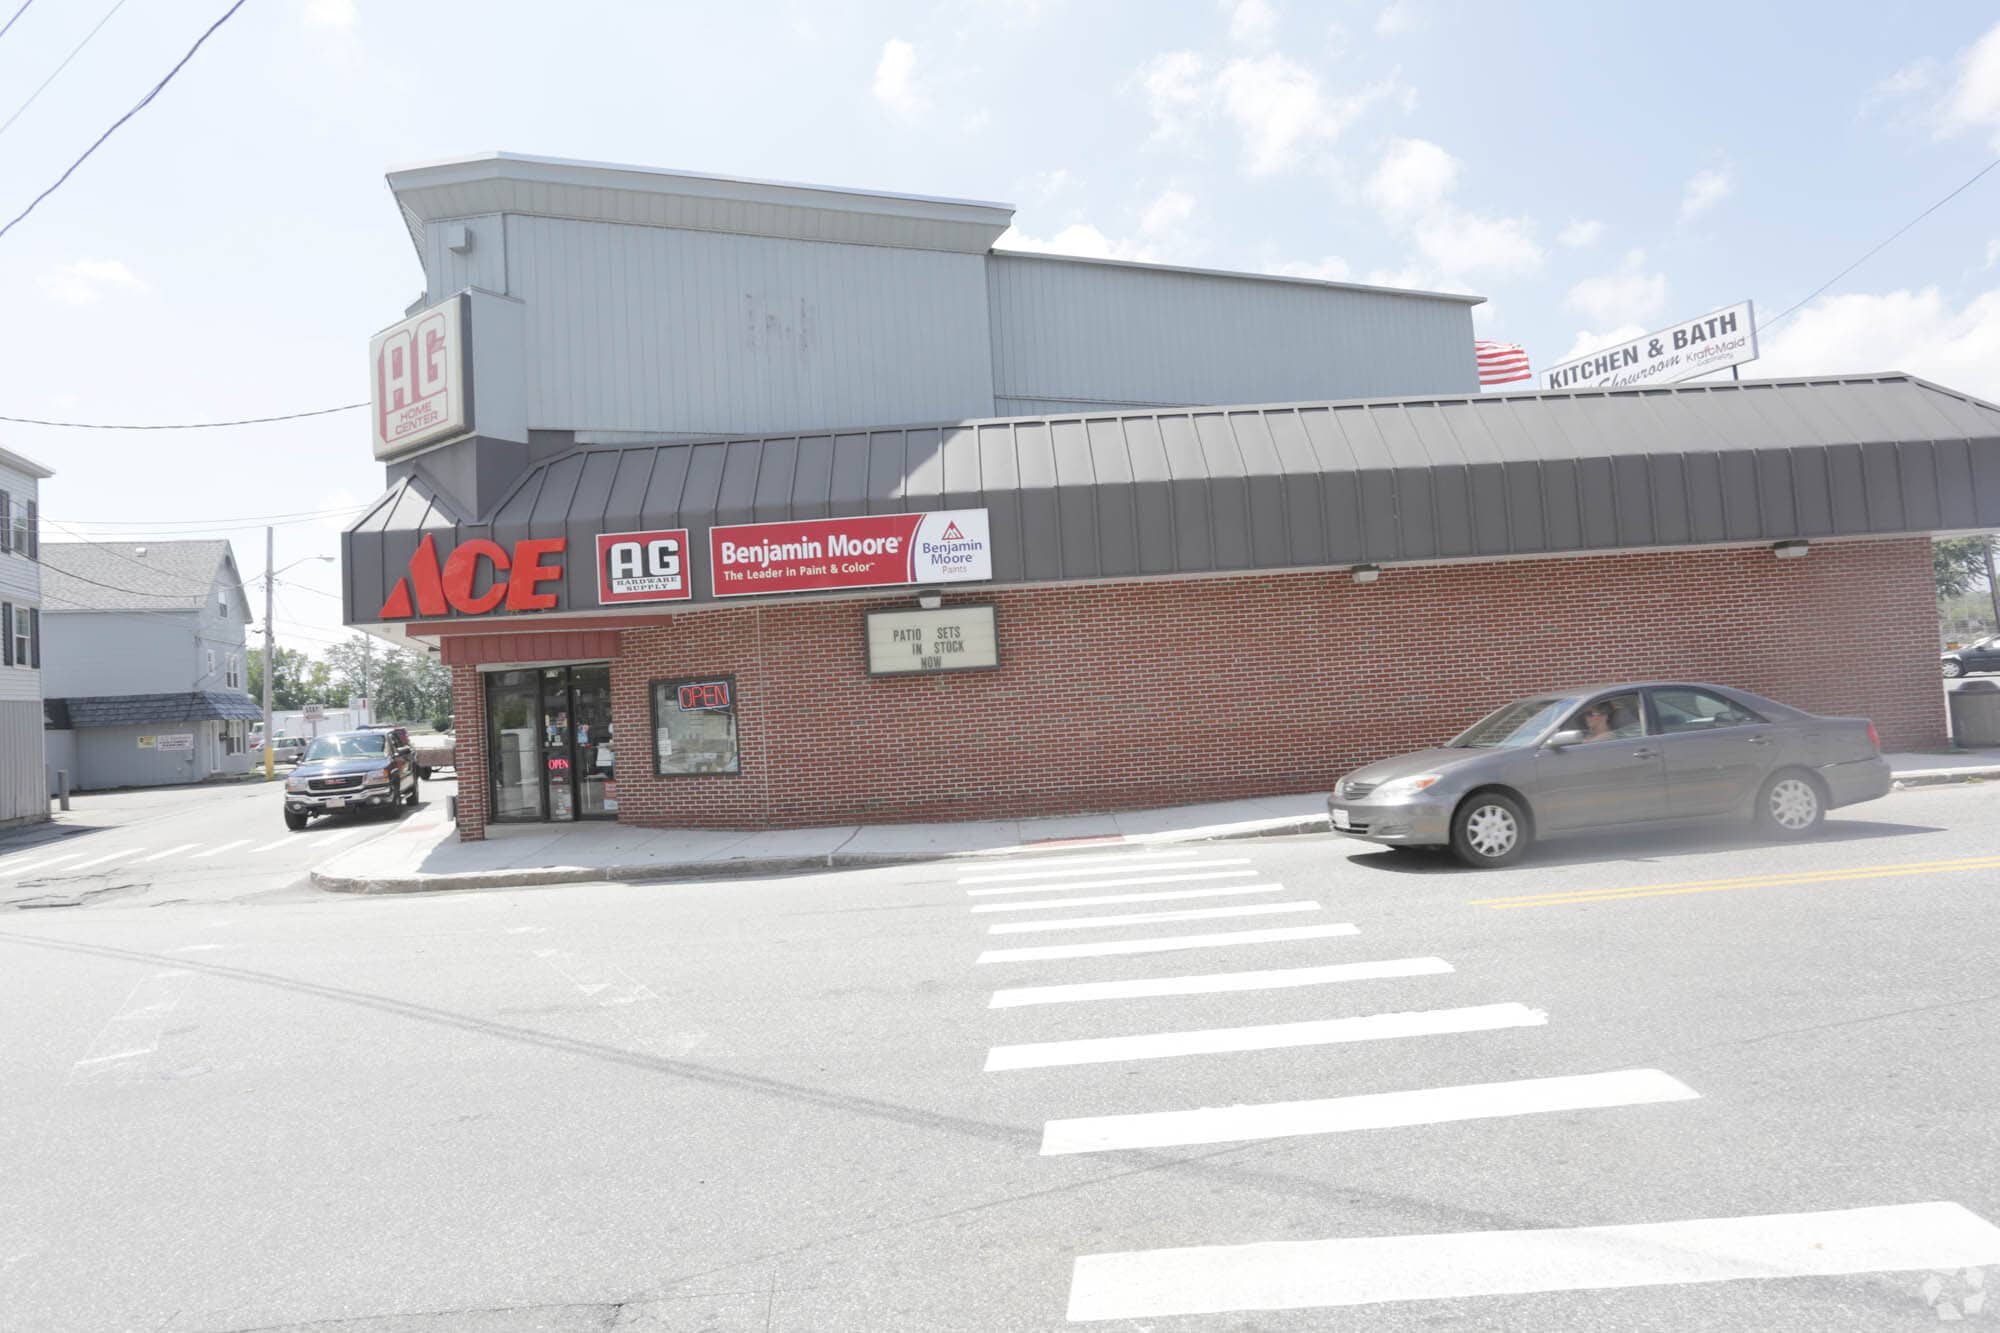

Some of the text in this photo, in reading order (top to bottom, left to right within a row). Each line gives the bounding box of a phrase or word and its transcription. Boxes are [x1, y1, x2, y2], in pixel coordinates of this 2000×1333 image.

[1549, 311, 1737, 389] KITCHEN & BATH
[379, 312, 447, 414] AG
[401, 401, 432, 421] HOME
[395, 411, 438, 435] CENTER
[721, 536, 822, 568] Benjamin
[923, 539, 982, 556] Benjamin
[611, 540, 680, 578] AG
[931, 554, 973, 565] Moore
[378, 532, 567, 619] ACE
[724, 570, 743, 581] The
[747, 567, 782, 580] Leader
[786, 567, 796, 577] in
[800, 564, 827, 576] Paint
[830, 563, 838, 574] &
[942, 565, 967, 575] Paints
[616, 577, 678, 586] HARDWARE
[626, 584, 668, 592] SUPPLY
[893, 626, 960, 642] PATIO SETS
[912, 640, 964, 655] IN STOCK
[921, 656, 942, 669] NOW
[680, 684, 728, 708] OPEN
[548, 759, 569, 770] OPEN
